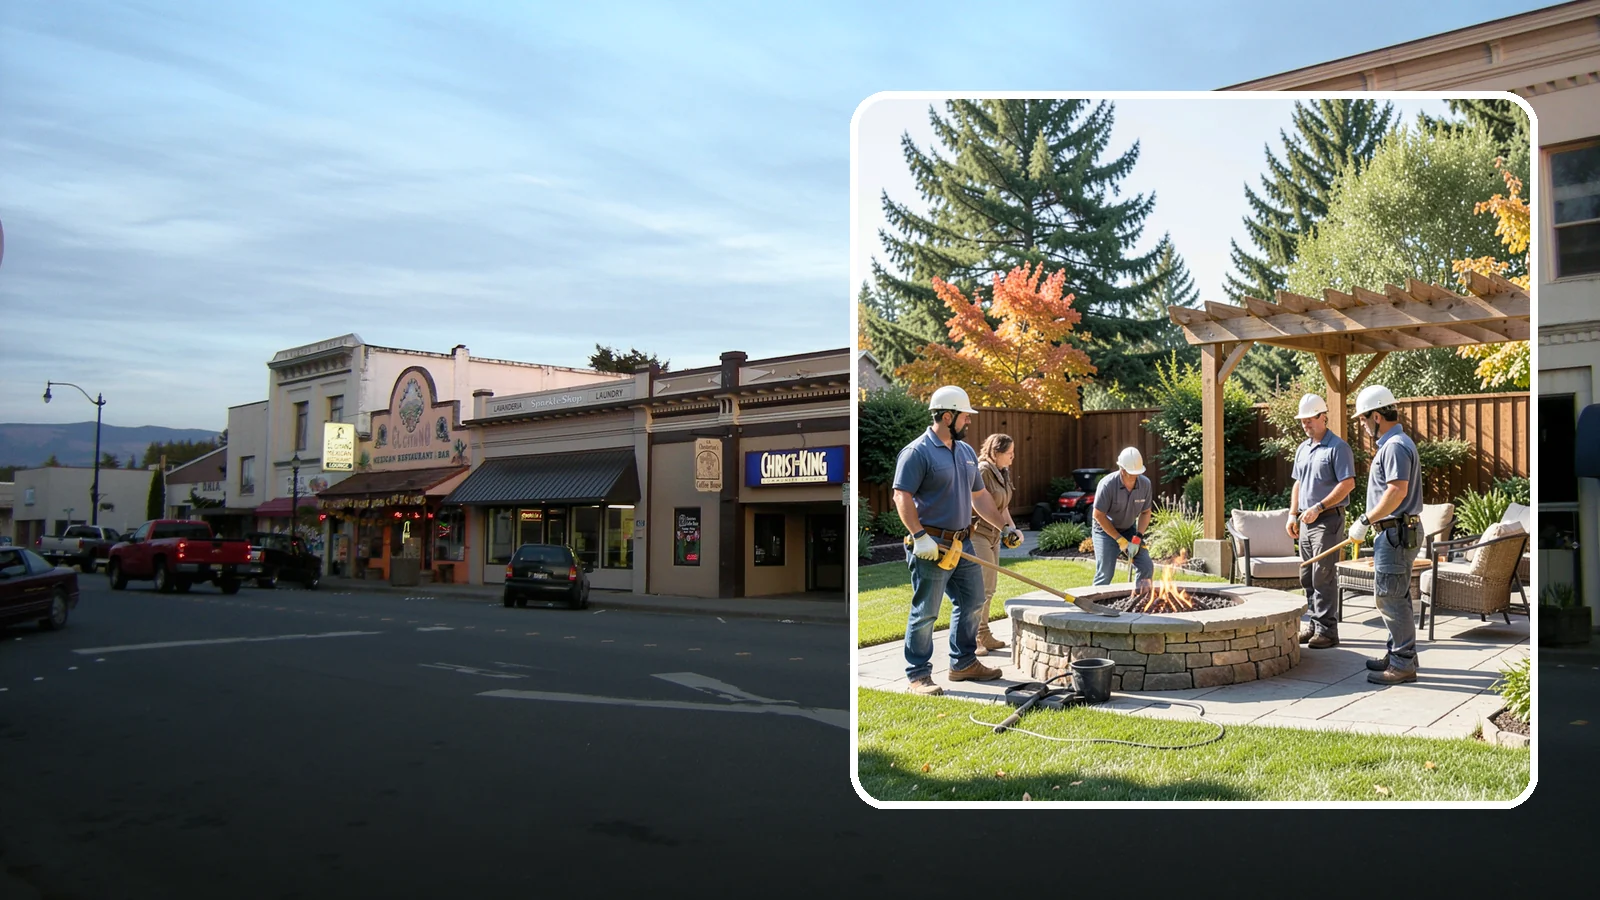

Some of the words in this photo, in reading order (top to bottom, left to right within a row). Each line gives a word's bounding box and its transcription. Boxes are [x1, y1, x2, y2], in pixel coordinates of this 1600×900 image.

[562, 394, 582, 405] Shop
[595, 389, 624, 400] LAUNDRY
[493, 402, 522, 413] LAVANDERIA
[392, 425, 402, 449] EL
[373, 455, 397, 464] MEXICAN
[397, 451, 434, 462] RESTAURANT
[437, 450, 450, 459] BAR
[760, 452, 798, 478] CHRIST
[798, 450, 828, 477] KING
